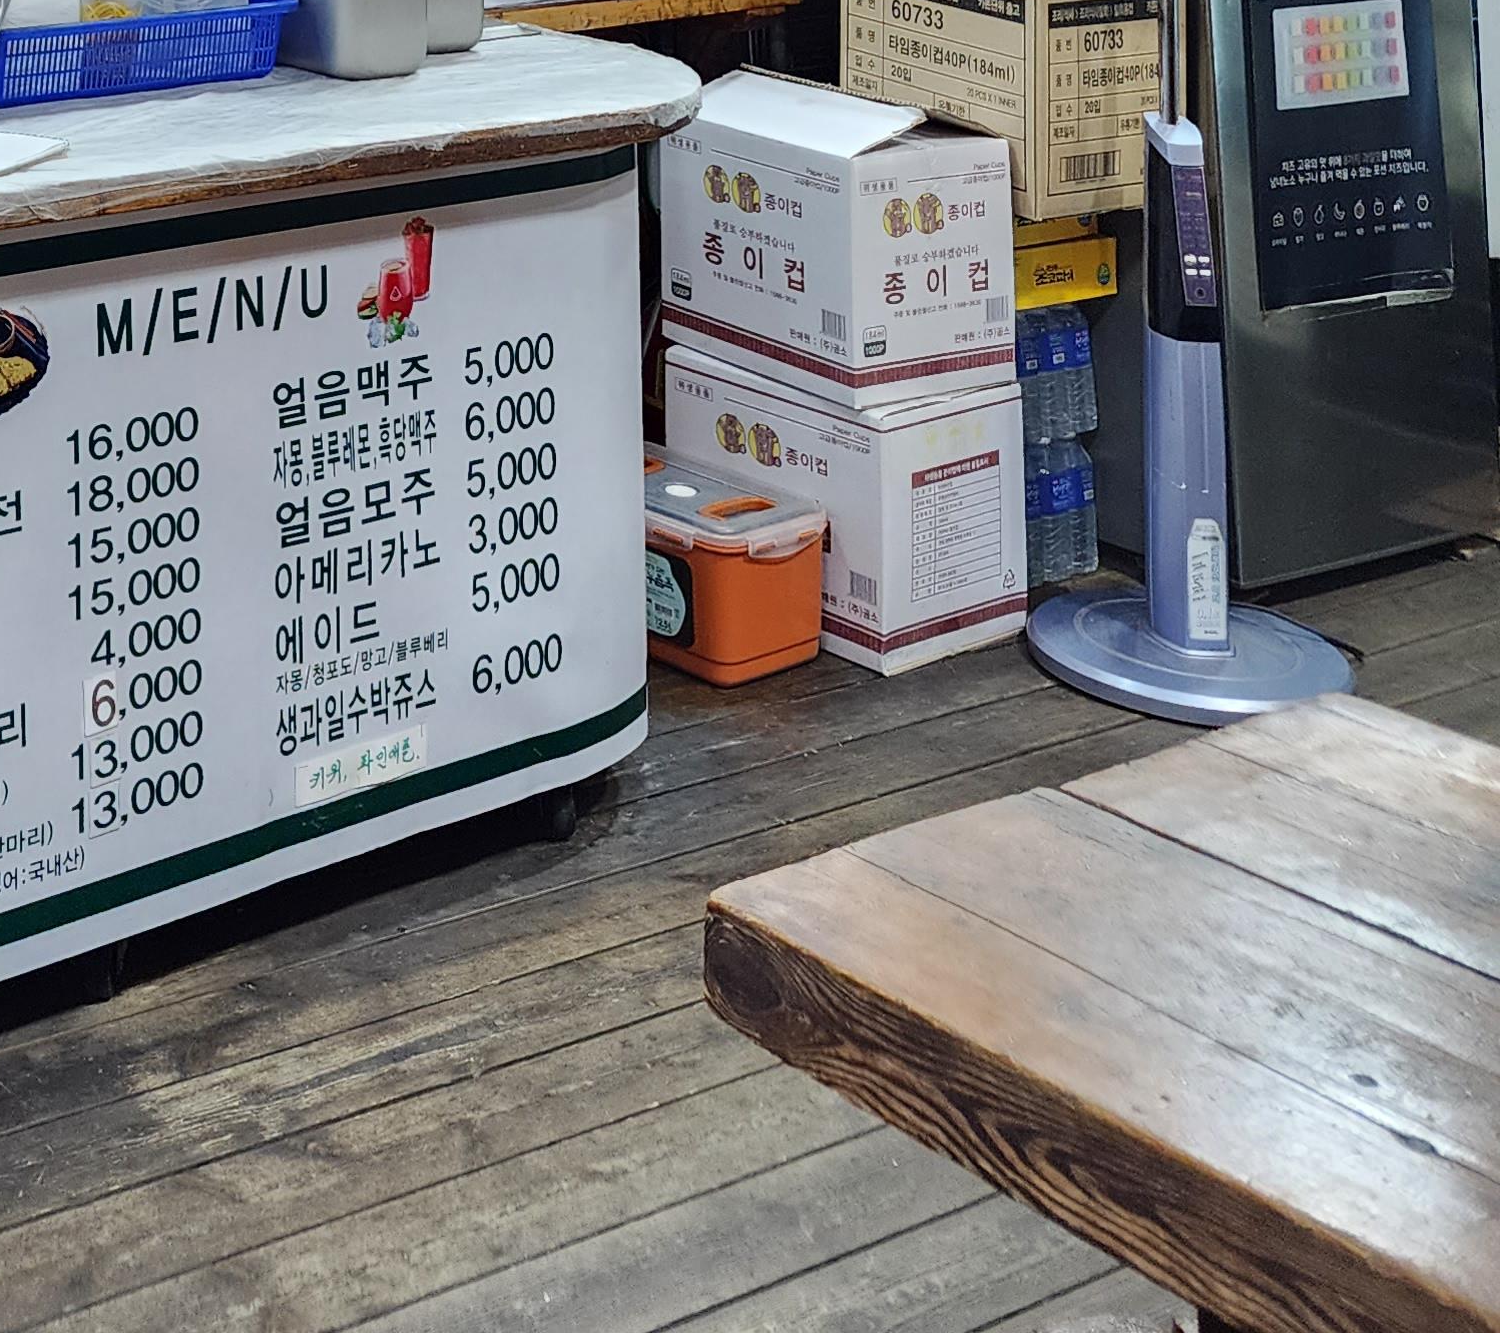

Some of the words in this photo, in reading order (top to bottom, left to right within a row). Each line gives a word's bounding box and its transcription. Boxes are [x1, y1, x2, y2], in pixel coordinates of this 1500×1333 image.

[891, 0, 944, 30] 60733
[1084, 28, 1124, 52] 60733
[888, 34, 1016, 84] 타임종이컵40P(184ml)
[891, 64, 912, 83] 20입
[764, 193, 803, 219] 종이컵
[947, 199, 986, 221] 종이컵
[739, 226, 796, 253] 승부하겠습니다
[922, 244, 980, 263] 승부하겠습니다
[273, 354, 434, 429] 얼음맥주
[464, 333, 554, 387] 5,000
[65, 406, 199, 465] 16,000
[465, 387, 556, 442] 6,000
[66, 456, 200, 517] 18,000
[785, 446, 829, 478] 종이컵
[275, 468, 436, 549] 얼음모주
[466, 442, 557, 499] 5,000
[67, 506, 201, 569] 15,000
[275, 529, 441, 604] 아메리카노
[468, 497, 558, 555] 3,000
[68, 557, 201, 621] 15,000
[275, 601, 380, 664] 에이드
[472, 553, 560, 613] 5,000
[90, 608, 202, 668] 4,000
[91, 659, 203, 727] 6,000
[276, 669, 437, 757] 생과일수박쥬스
[472, 633, 563, 696] 6,000
[71, 710, 204, 781] 13,000
[71, 762, 204, 834] 13,000
